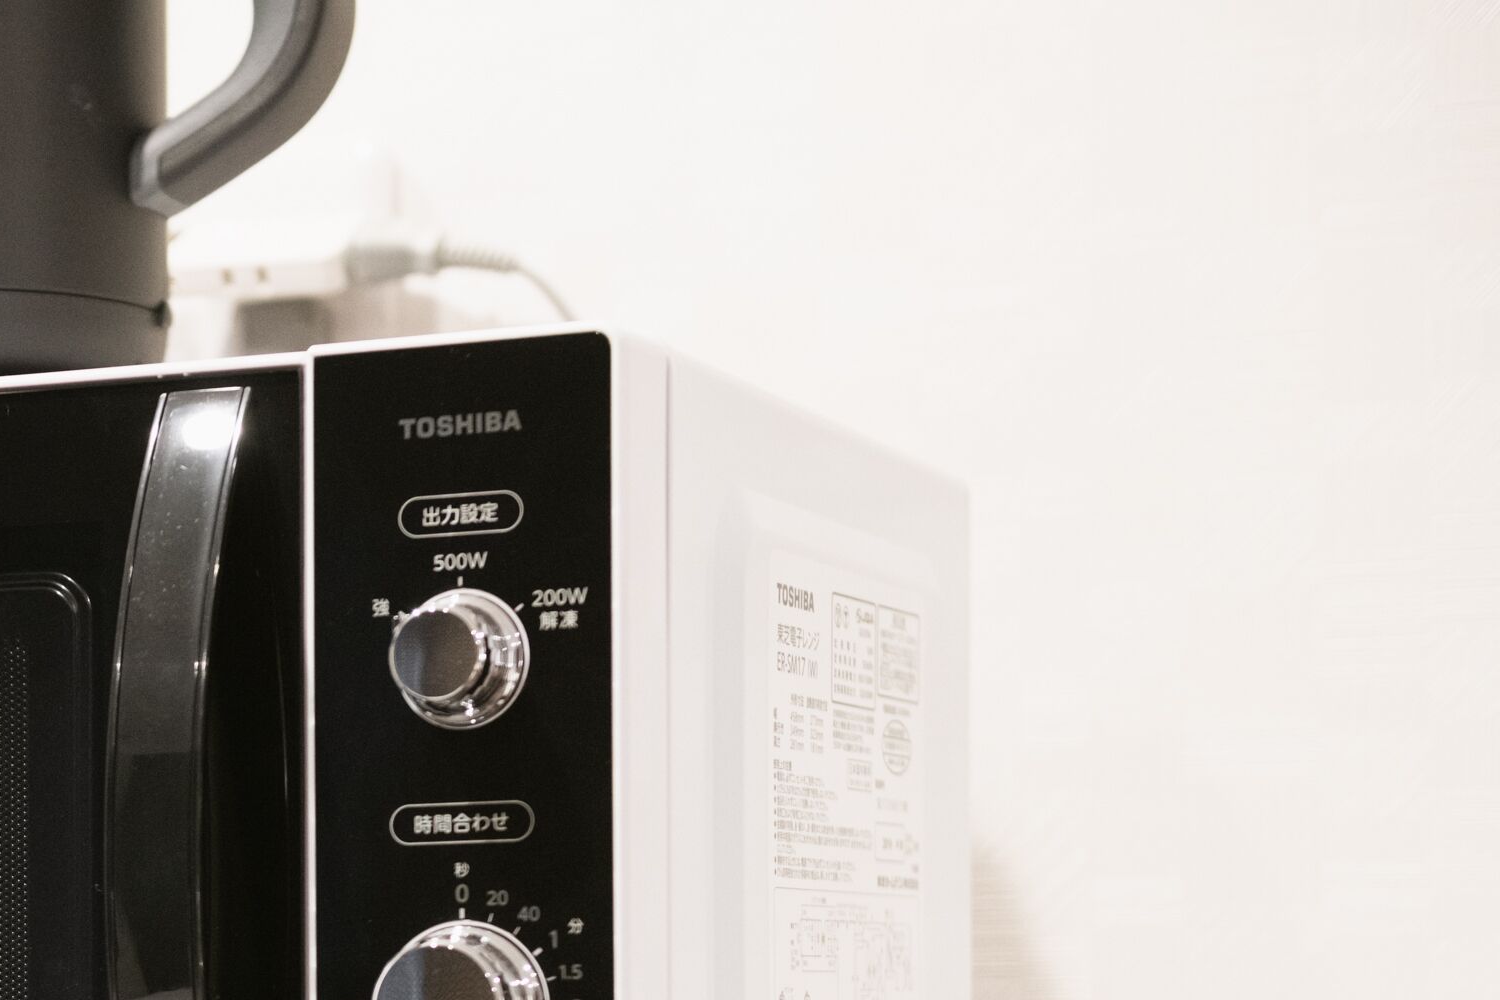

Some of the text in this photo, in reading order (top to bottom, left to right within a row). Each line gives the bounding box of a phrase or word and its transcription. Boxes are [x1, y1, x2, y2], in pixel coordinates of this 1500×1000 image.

[399, 409, 522, 440] TOSHIBA
[422, 502, 499, 526] 出力設定
[433, 552, 488, 571] 500W
[532, 587, 588, 607] 200W
[776, 582, 815, 613] TOSHIBA
[372, 599, 390, 617] 強
[539, 610, 579, 630] 解凍
[776, 623, 820, 651] 東芝電子レンジ
[776, 651, 806, 677] ER-SM17
[413, 812, 509, 834] 時間合わせ
[454, 862, 470, 878] 秒
[455, 885, 469, 903] 0
[487, 890, 509, 906] 20
[518, 906, 541, 922] 40
[568, 918, 584, 935] 分
[549, 931, 559, 947] 1
[559, 964, 583, 980] 1.5
